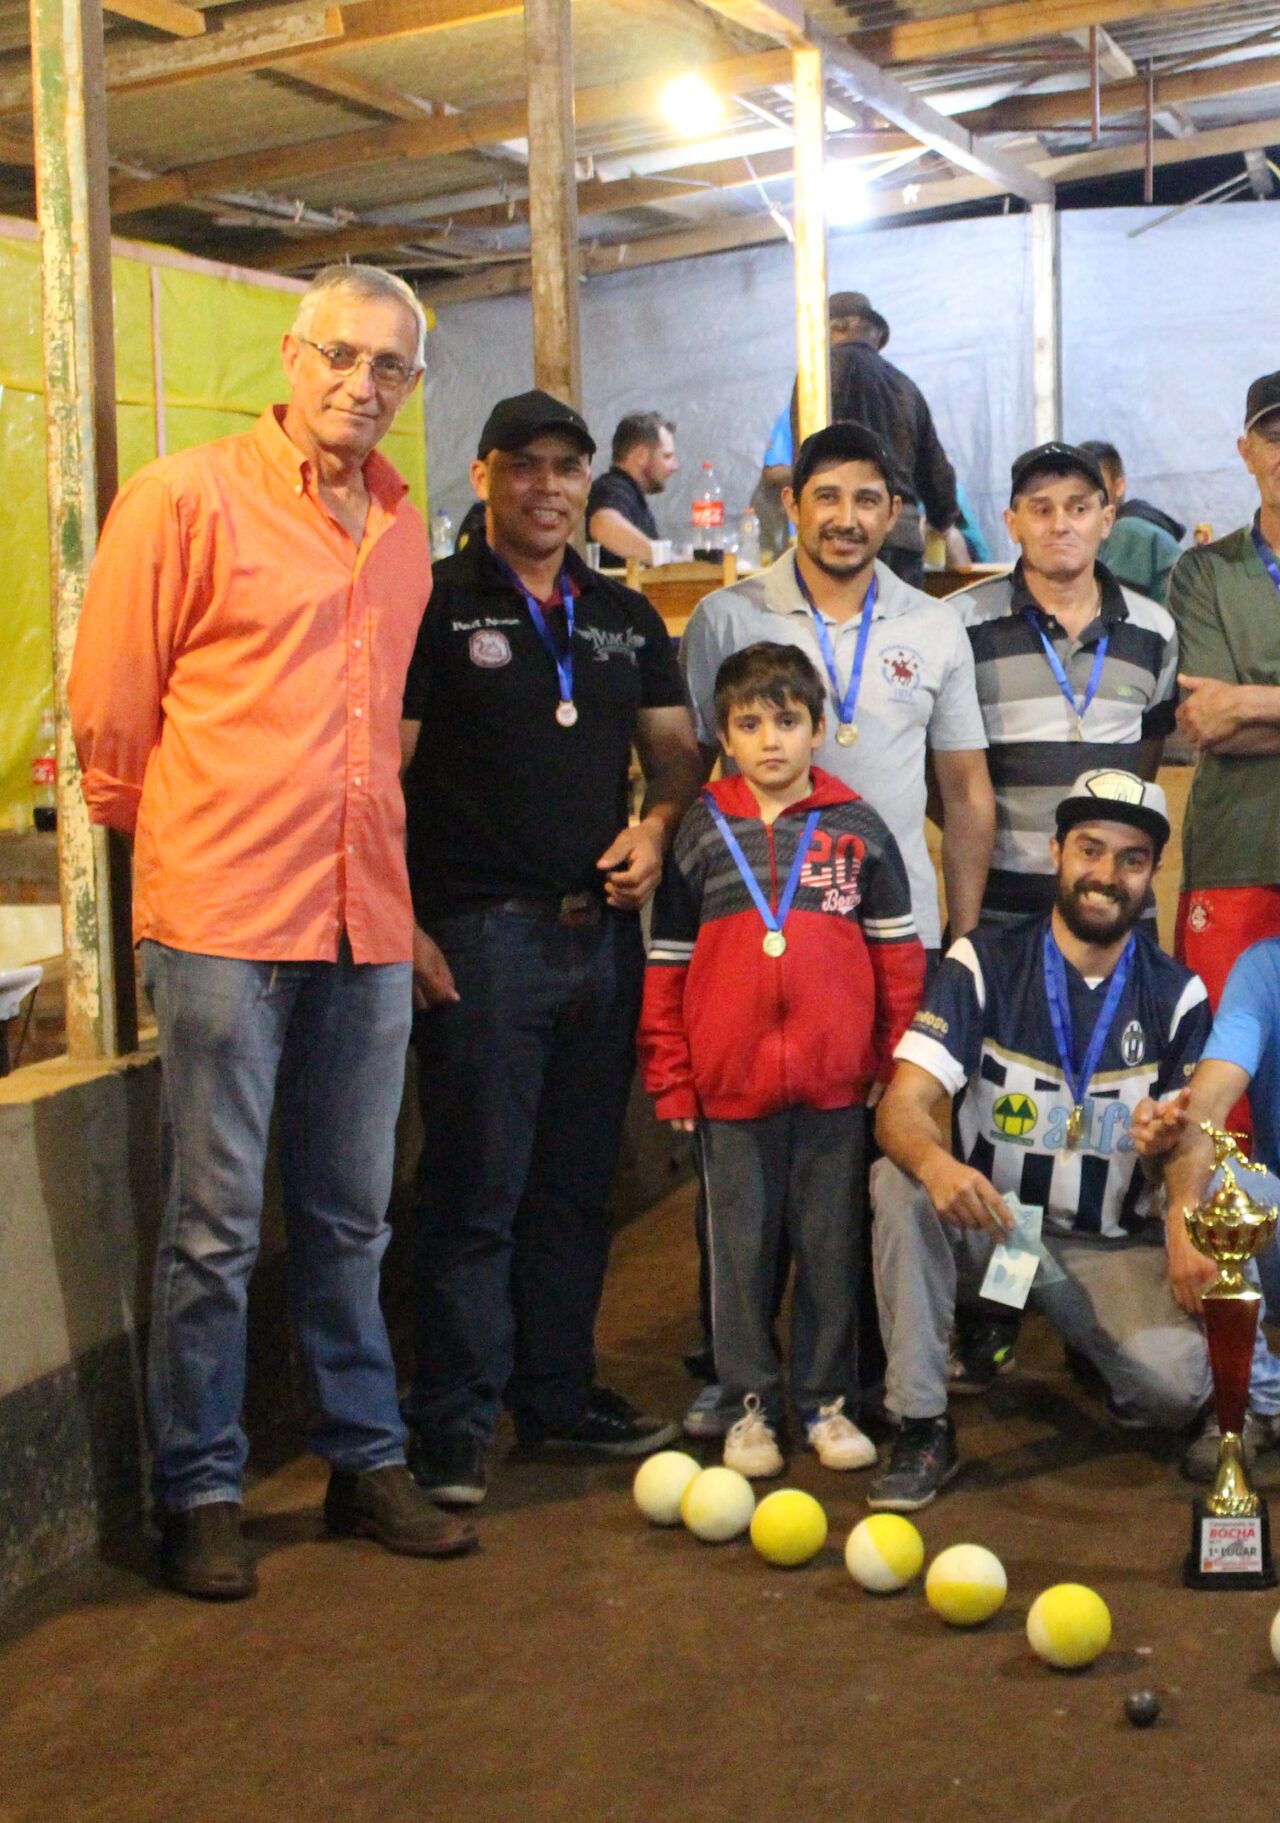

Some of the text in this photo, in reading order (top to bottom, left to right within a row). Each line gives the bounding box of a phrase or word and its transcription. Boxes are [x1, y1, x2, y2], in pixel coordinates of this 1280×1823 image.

[800, 829, 866, 894] 20
[1209, 1528, 1256, 1538] BOCHA
[1221, 1547, 1257, 1558] LUGAR
